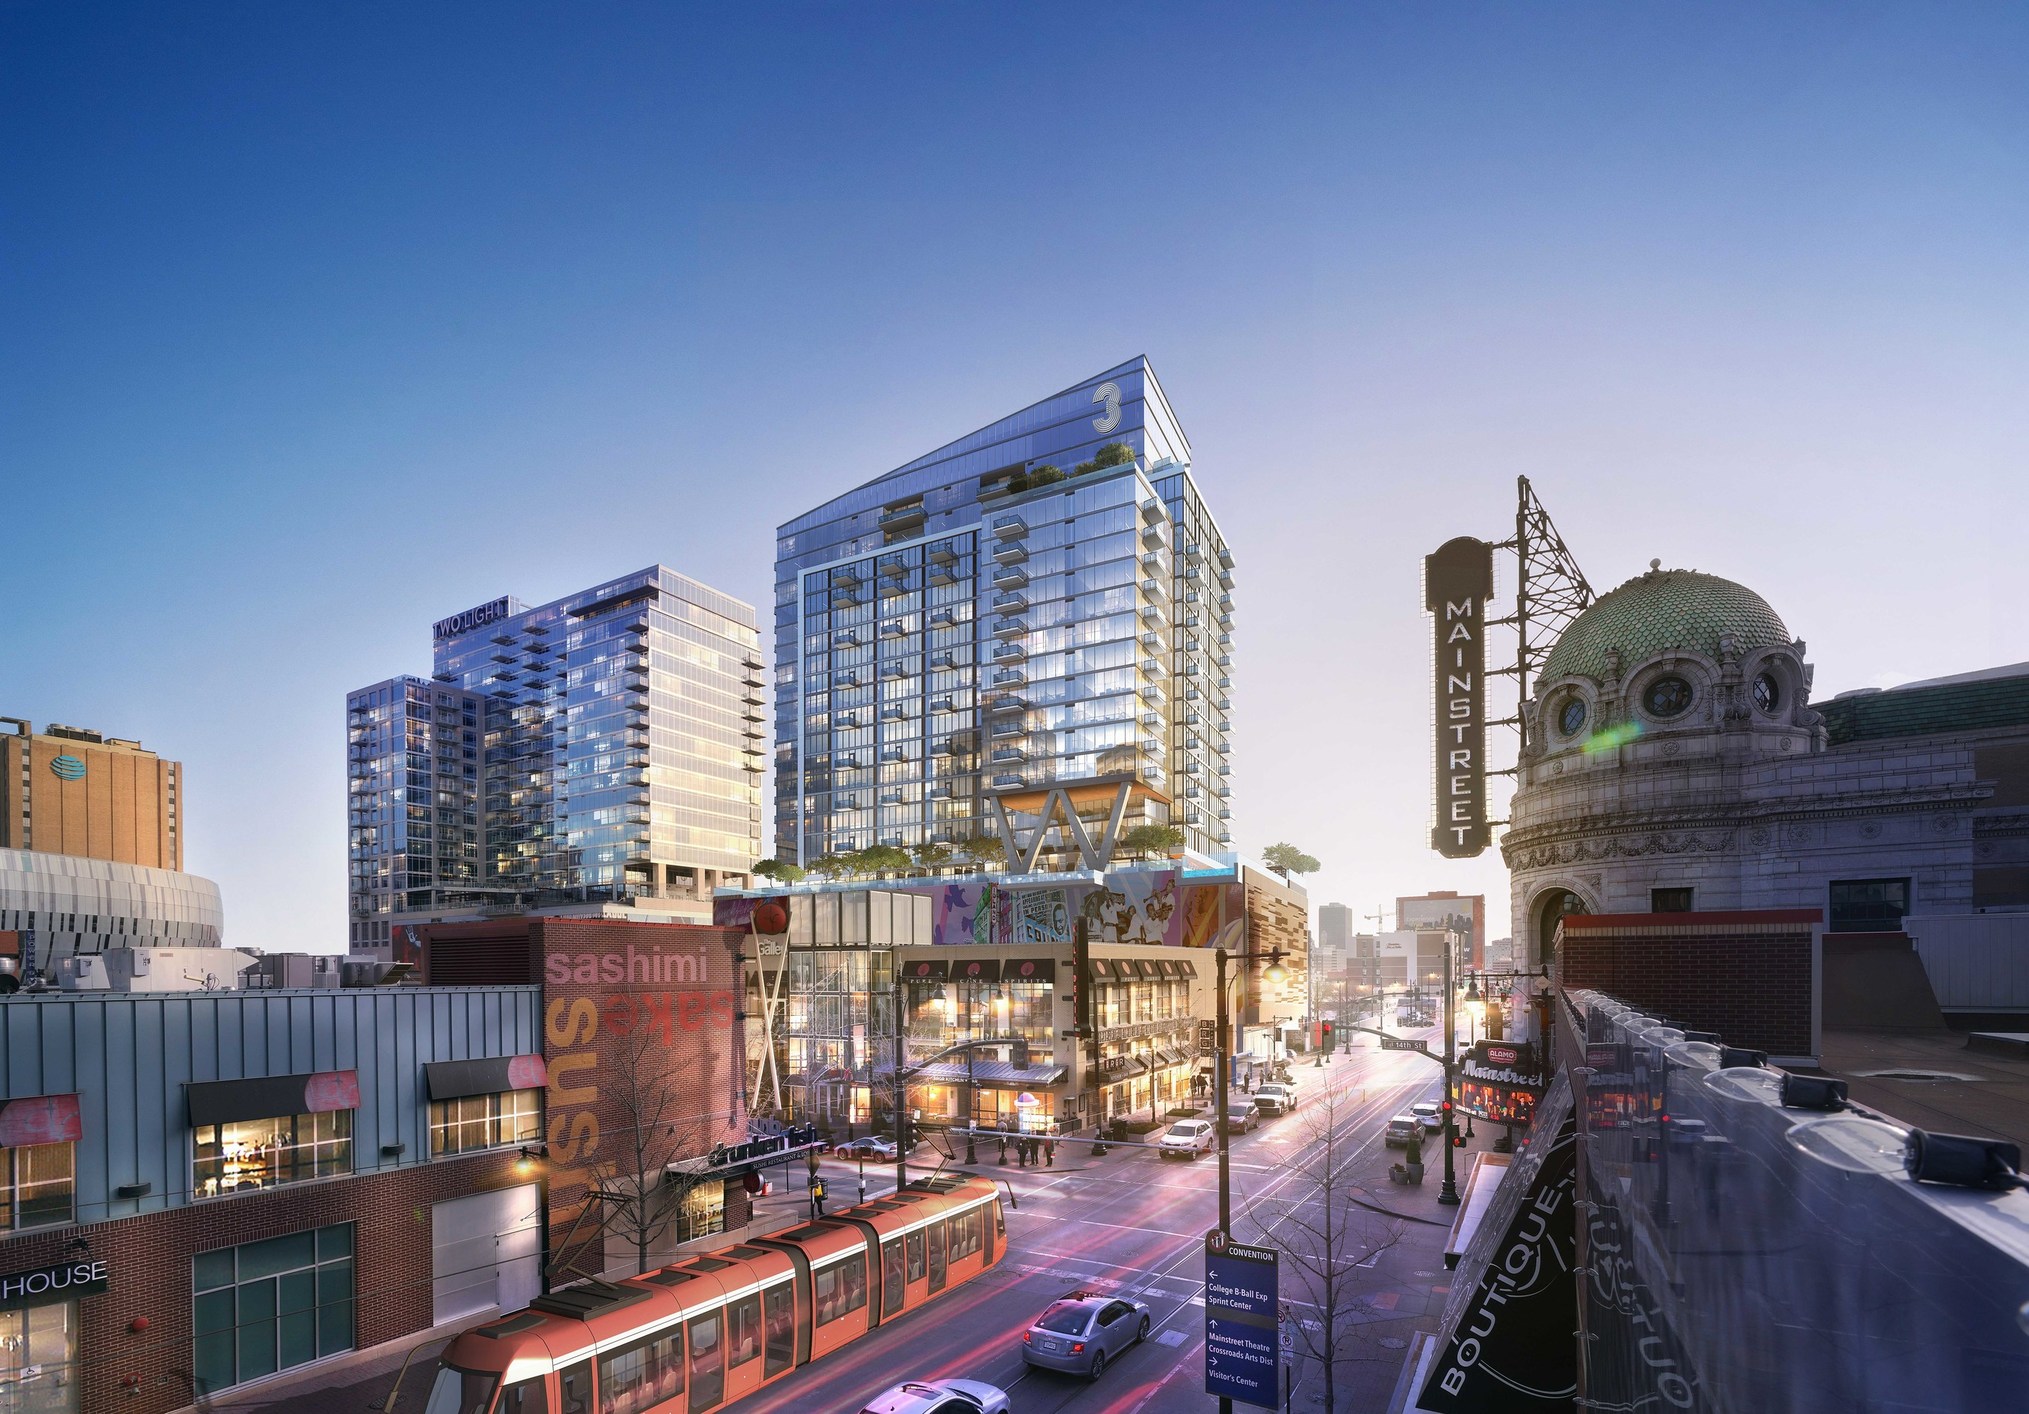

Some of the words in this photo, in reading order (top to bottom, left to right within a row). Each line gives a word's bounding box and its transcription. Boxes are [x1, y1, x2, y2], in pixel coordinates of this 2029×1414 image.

[1092, 382, 1122, 434] 3
[433, 614, 460, 639] TWO
[464, 599, 502, 628] LIGHT
[1447, 597, 1472, 845] MAINSTREET
[546, 945, 707, 984] sashimi
[603, 991, 734, 1046] sake
[1489, 1050, 1514, 1058] ALAMO
[1461, 1059, 1543, 1087] Mainstreet
[707, 1134, 784, 1168] drunken
[786, 1121, 816, 1149] fish
[768, 1151, 796, 1167] RESTAURANT
[1229, 1247, 1274, 1261] CONVENTION
[3, 1260, 108, 1299] HOUSE
[1208, 1283, 1234, 1296] College
[1234, 1287, 1254, 1298] B-Ball
[1255, 1291, 1268, 1302] Exp
[1440, 1185, 1560, 1397] BOUTIQUE
[1208, 1295, 1229, 1306] Sprint
[1229, 1299, 1252, 1310] Center
[1208, 1332, 1244, 1347] Mainstreet
[1245, 1339, 1271, 1353] Theatre
[1208, 1344, 1244, 1360] Crossroads
[1244, 1352, 1258, 1363] Arts
[1259, 1356, 1274, 1366] Dist
[1208, 1369, 1235, 1383] Visitor's
[1235, 1375, 1259, 1388] Center
